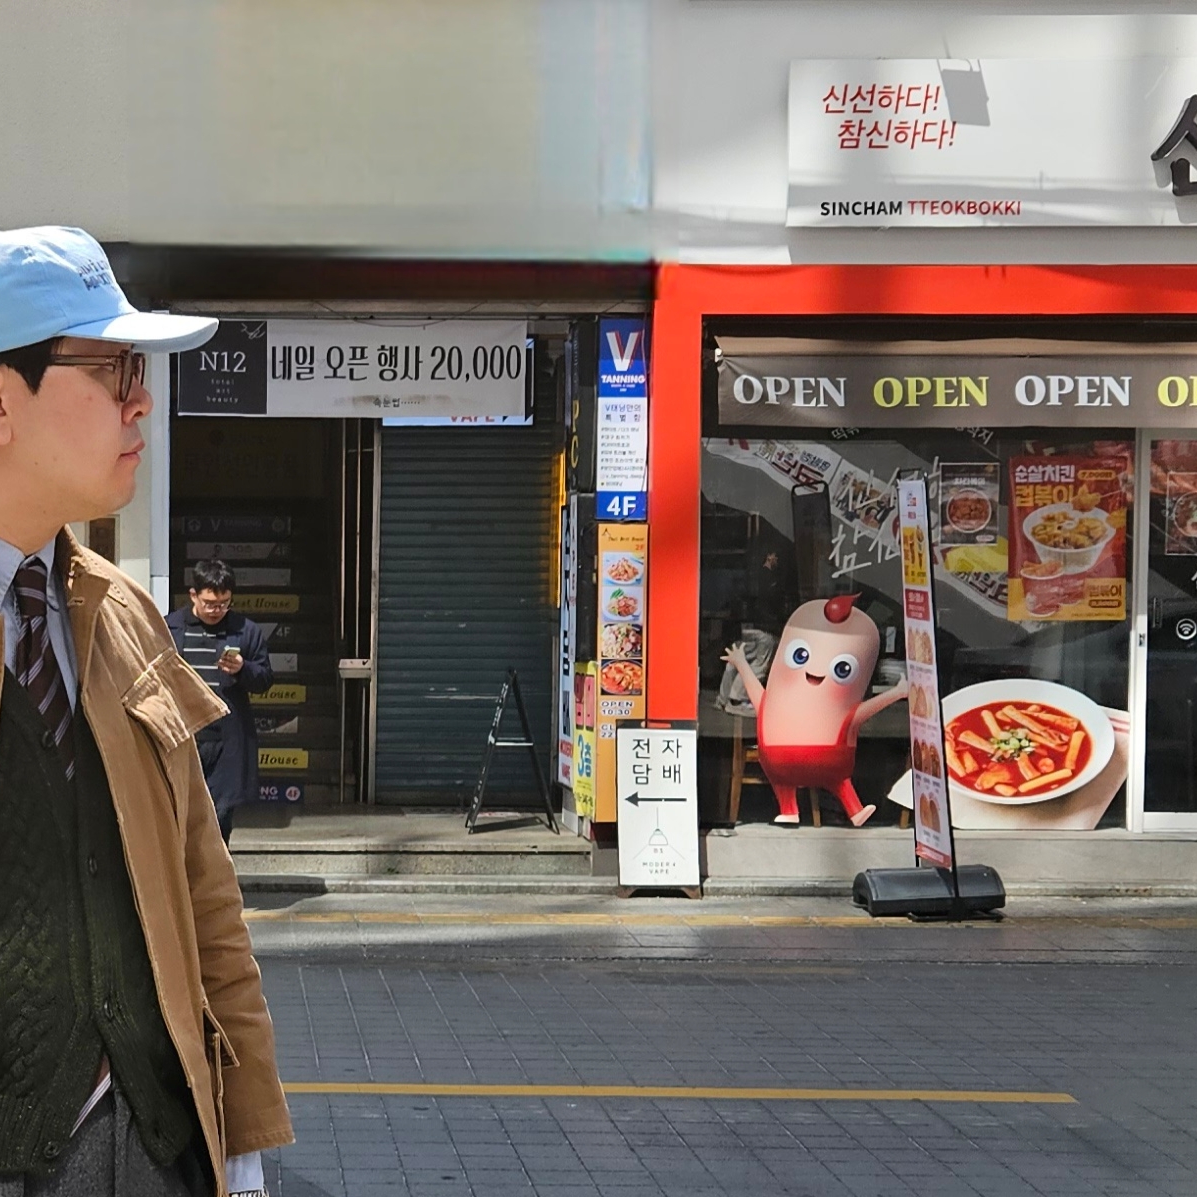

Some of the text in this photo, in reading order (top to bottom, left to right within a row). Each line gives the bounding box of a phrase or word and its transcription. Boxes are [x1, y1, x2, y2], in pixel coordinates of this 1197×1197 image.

[822, 83, 941, 114] 신선하다!
[838, 119, 957, 149] 참신하다!
[820, 200, 1022, 216] SINCHAM TTEOKBOKKI
[606, 331, 640, 371] V
[200, 351, 246, 373] N12
[271, 344, 522, 383] 네일 오픈 행사 20,000
[601, 375, 646, 384] TANNING
[206, 395, 238, 404] beauty
[733, 374, 847, 407] OPEN
[873, 376, 989, 408] OPEN
[1015, 375, 1132, 406] OPEN
[1015, 465, 1076, 483] 순살치킨
[607, 496, 637, 516] 4F
[256, 597, 291, 608] House
[276, 626, 290, 637] 4F
[260, 754, 299, 765] House
